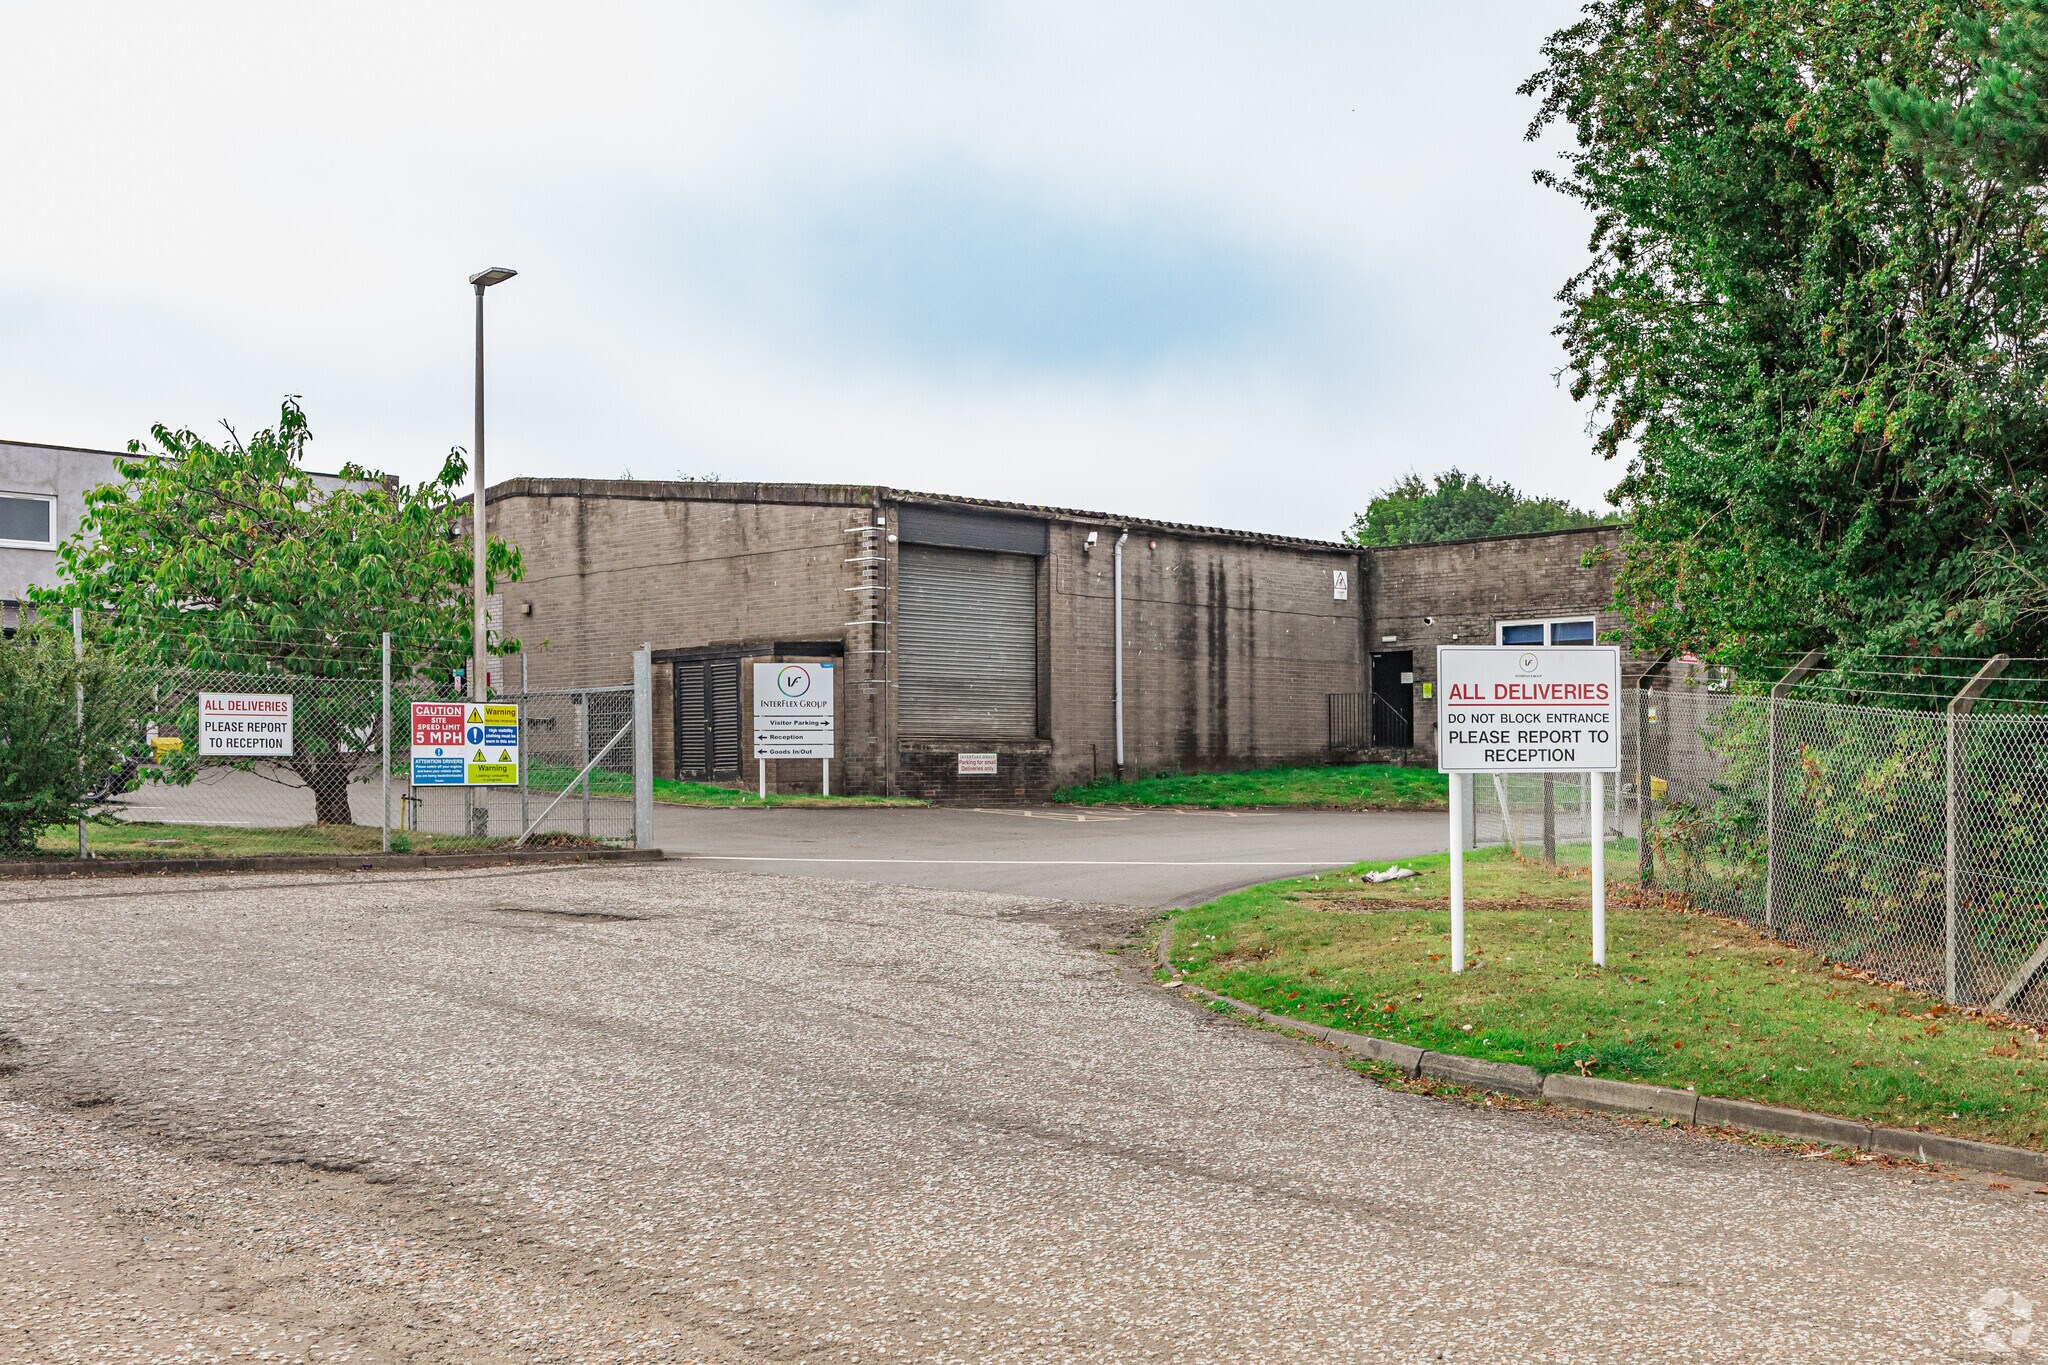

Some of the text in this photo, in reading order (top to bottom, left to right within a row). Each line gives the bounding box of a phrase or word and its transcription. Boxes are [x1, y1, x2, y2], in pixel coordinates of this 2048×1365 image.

[1448, 683, 1486, 700] ALL
[1494, 683, 1609, 700] DELIVERIES
[204, 699, 288, 712] ALL DELIVERIES
[799, 699, 828, 709] GROUP
[415, 706, 462, 716] CAUTION
[485, 708, 516, 717] Warning
[1448, 712, 1610, 724] DO NOT BLOCK ENTRANCE
[204, 721, 287, 733] PLEASE REPORT
[417, 723, 440, 731] SPEED
[416, 731, 462, 744] 5 MPH
[1449, 729, 1609, 744] PLEASE REPORT TO
[209, 737, 283, 749] TO RECEPTION
[1484, 749, 1575, 762] RECEPTION
[477, 764, 507, 773] Warning
